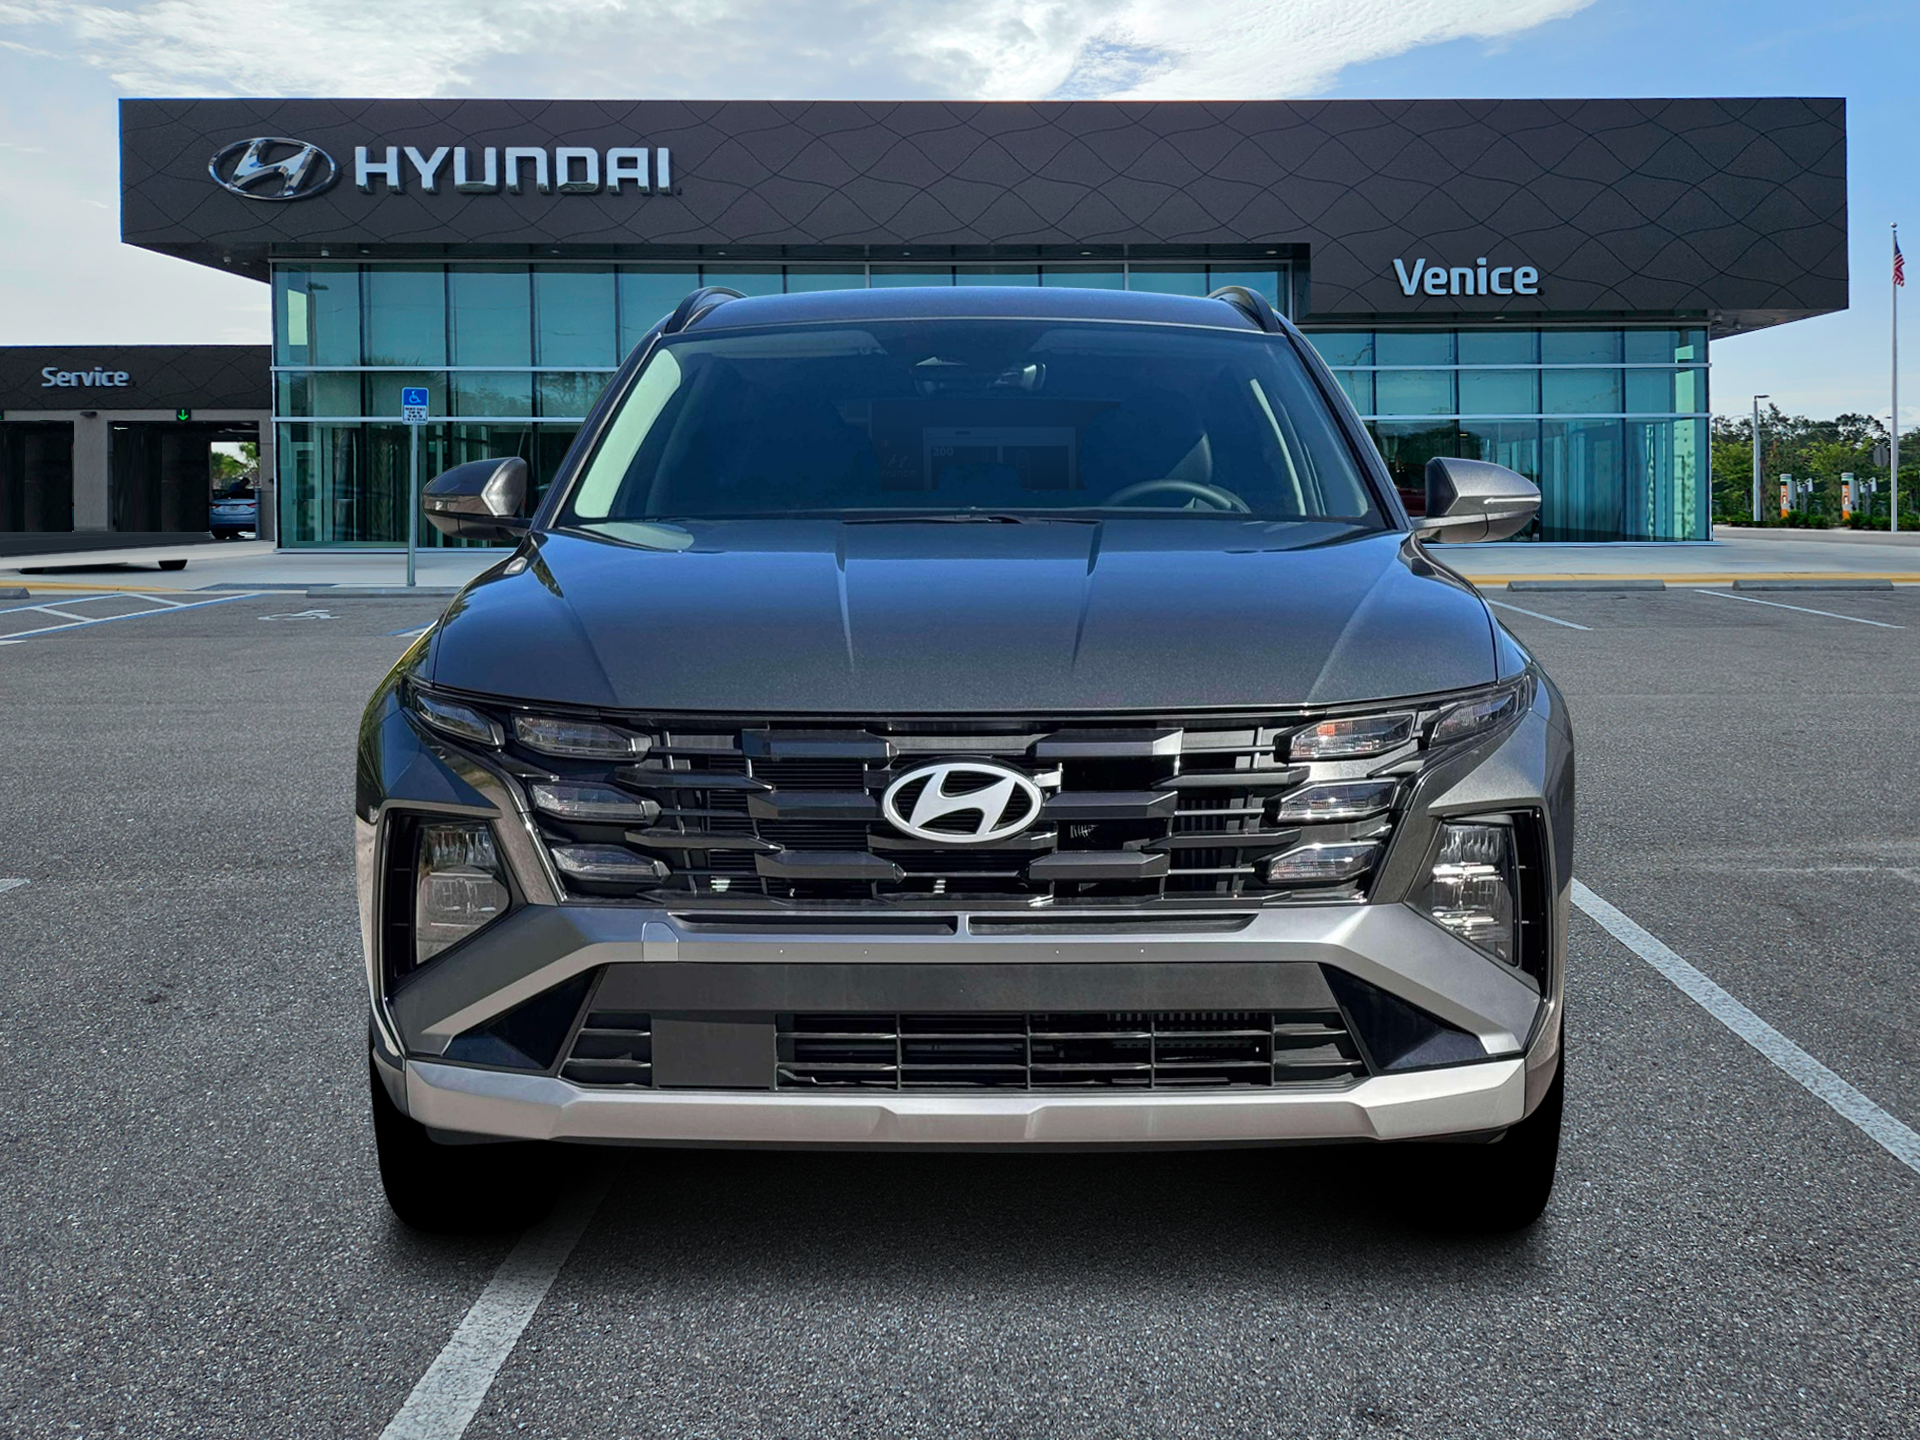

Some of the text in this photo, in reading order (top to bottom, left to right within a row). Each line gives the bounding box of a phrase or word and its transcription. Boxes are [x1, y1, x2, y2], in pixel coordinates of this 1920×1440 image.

[355, 146, 671, 194] HYUNDAI
[1393, 257, 1538, 296] Venice
[41, 366, 130, 387] Service
[932, 446, 955, 457] 200
